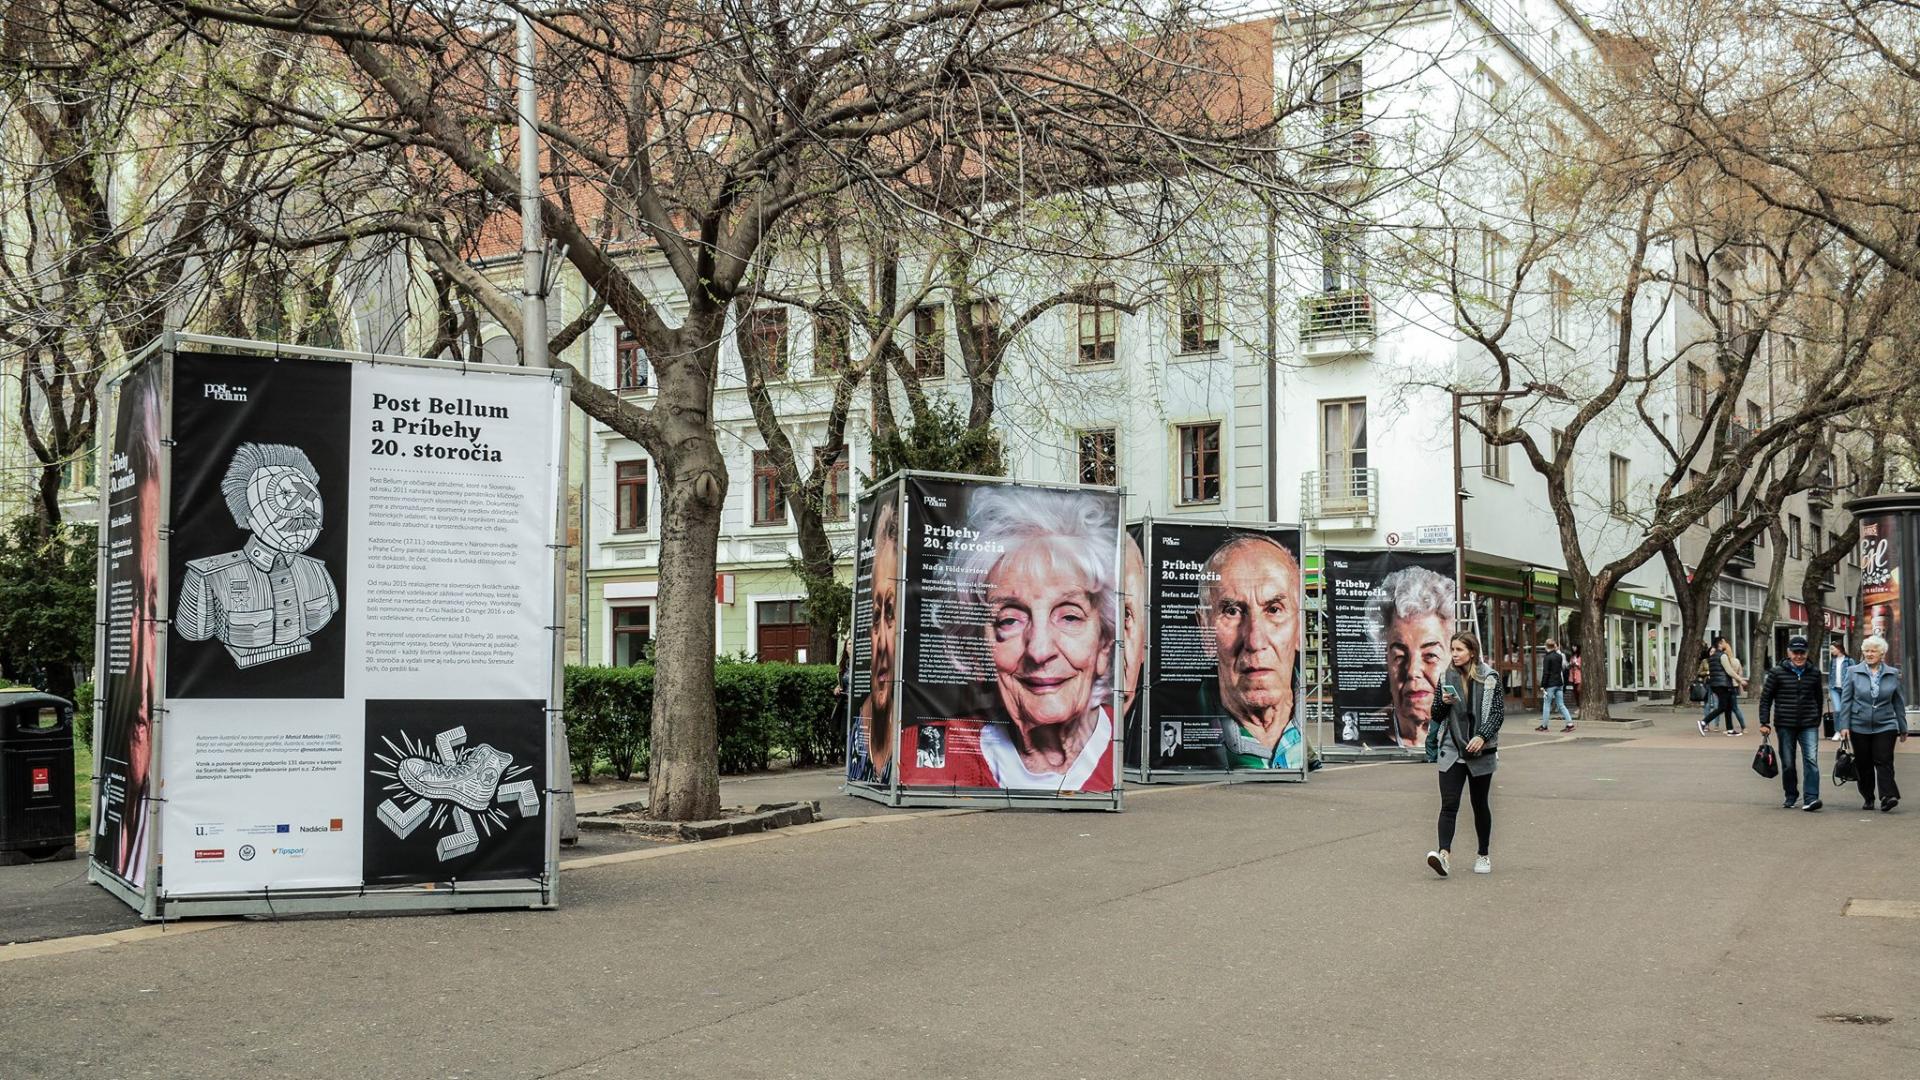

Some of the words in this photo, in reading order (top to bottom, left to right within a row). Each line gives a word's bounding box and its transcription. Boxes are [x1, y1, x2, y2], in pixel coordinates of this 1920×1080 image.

[204, 383, 226, 397] post
[214, 390, 247, 402] bellum
[372, 393, 421, 412] Post
[428, 397, 509, 419] Bellum
[371, 420, 384, 433] a
[393, 417, 481, 441] Príbehy
[371, 438, 406, 458] 20.
[413, 442, 503, 463] storočia
[924, 524, 980, 540] Príbehy
[923, 537, 943, 549] 20.
[946, 540, 1005, 553] storočia
[1162, 560, 1204, 572] Príbehy
[1161, 571, 1177, 580] 20.
[1179, 571, 1221, 581] storočia
[1335, 579, 1370, 589] Príbehy
[1335, 588, 1348, 596] 20.
[1350, 587, 1387, 596] storočia
[300, 825, 328, 833] Nadácia
[278, 847, 304, 855] Tipsport
